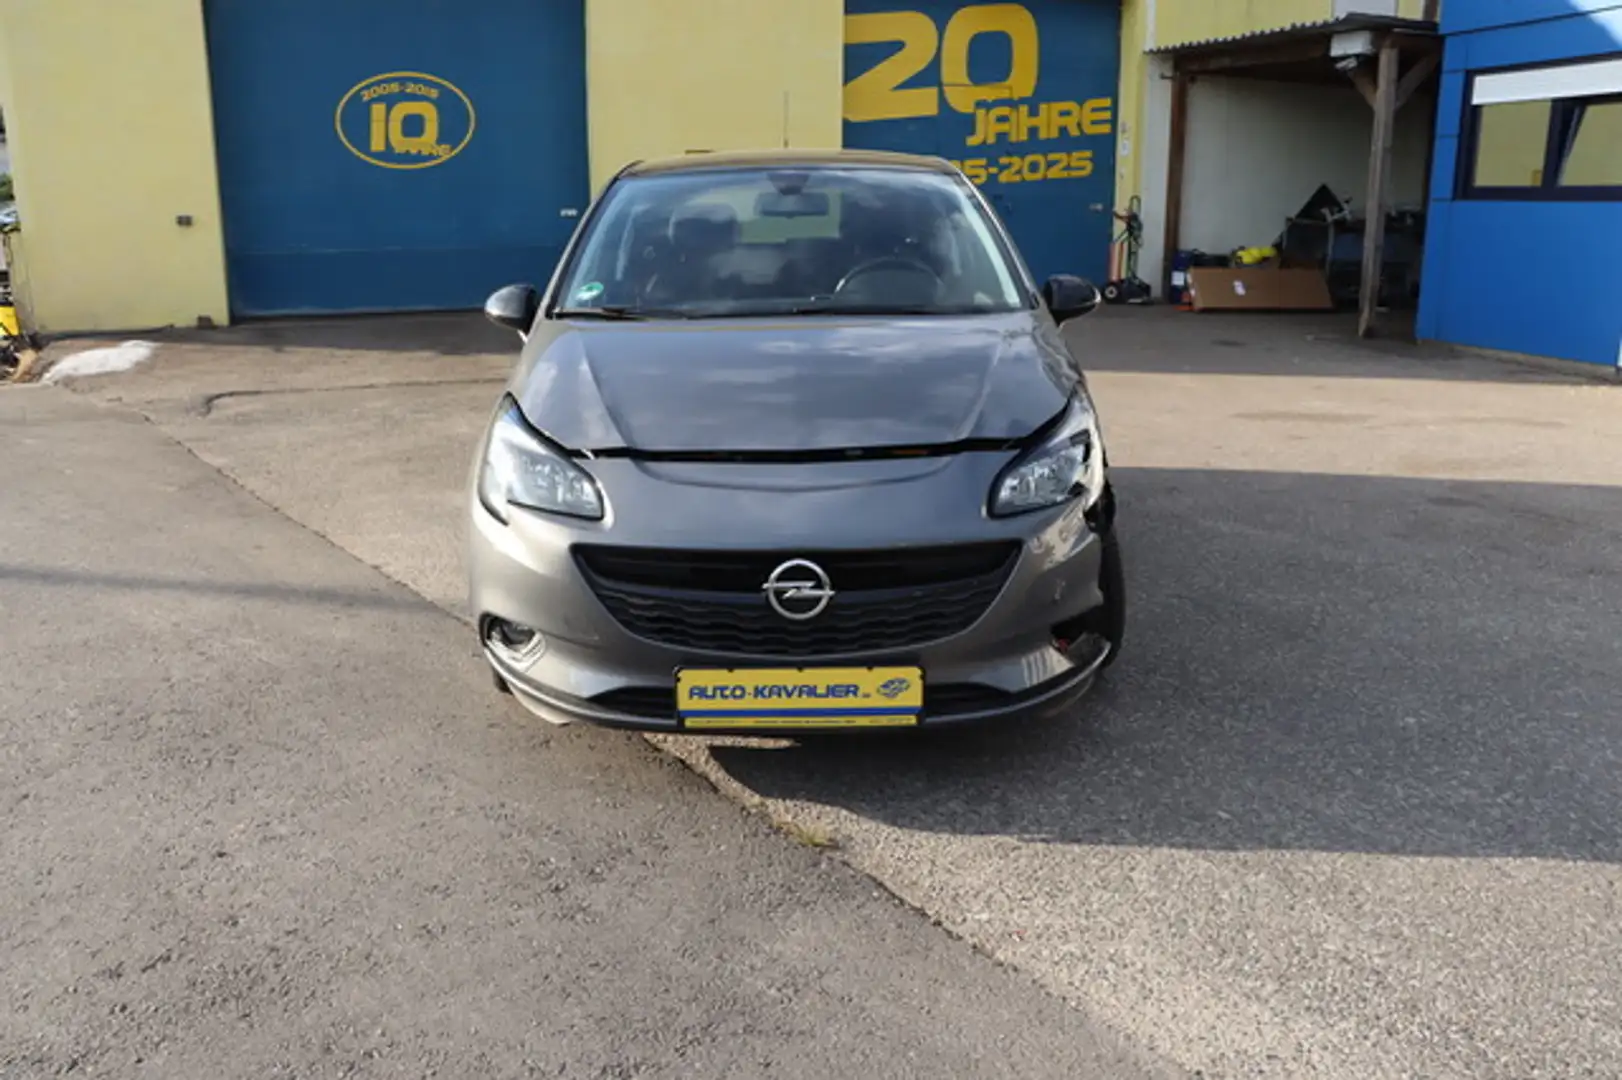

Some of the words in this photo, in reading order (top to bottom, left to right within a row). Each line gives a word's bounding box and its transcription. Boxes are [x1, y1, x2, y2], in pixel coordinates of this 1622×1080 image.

[842, 3, 1039, 123] 20
[965, 97, 1112, 147] JAHRE
[950, 150, 1094, 186] 5-2025
